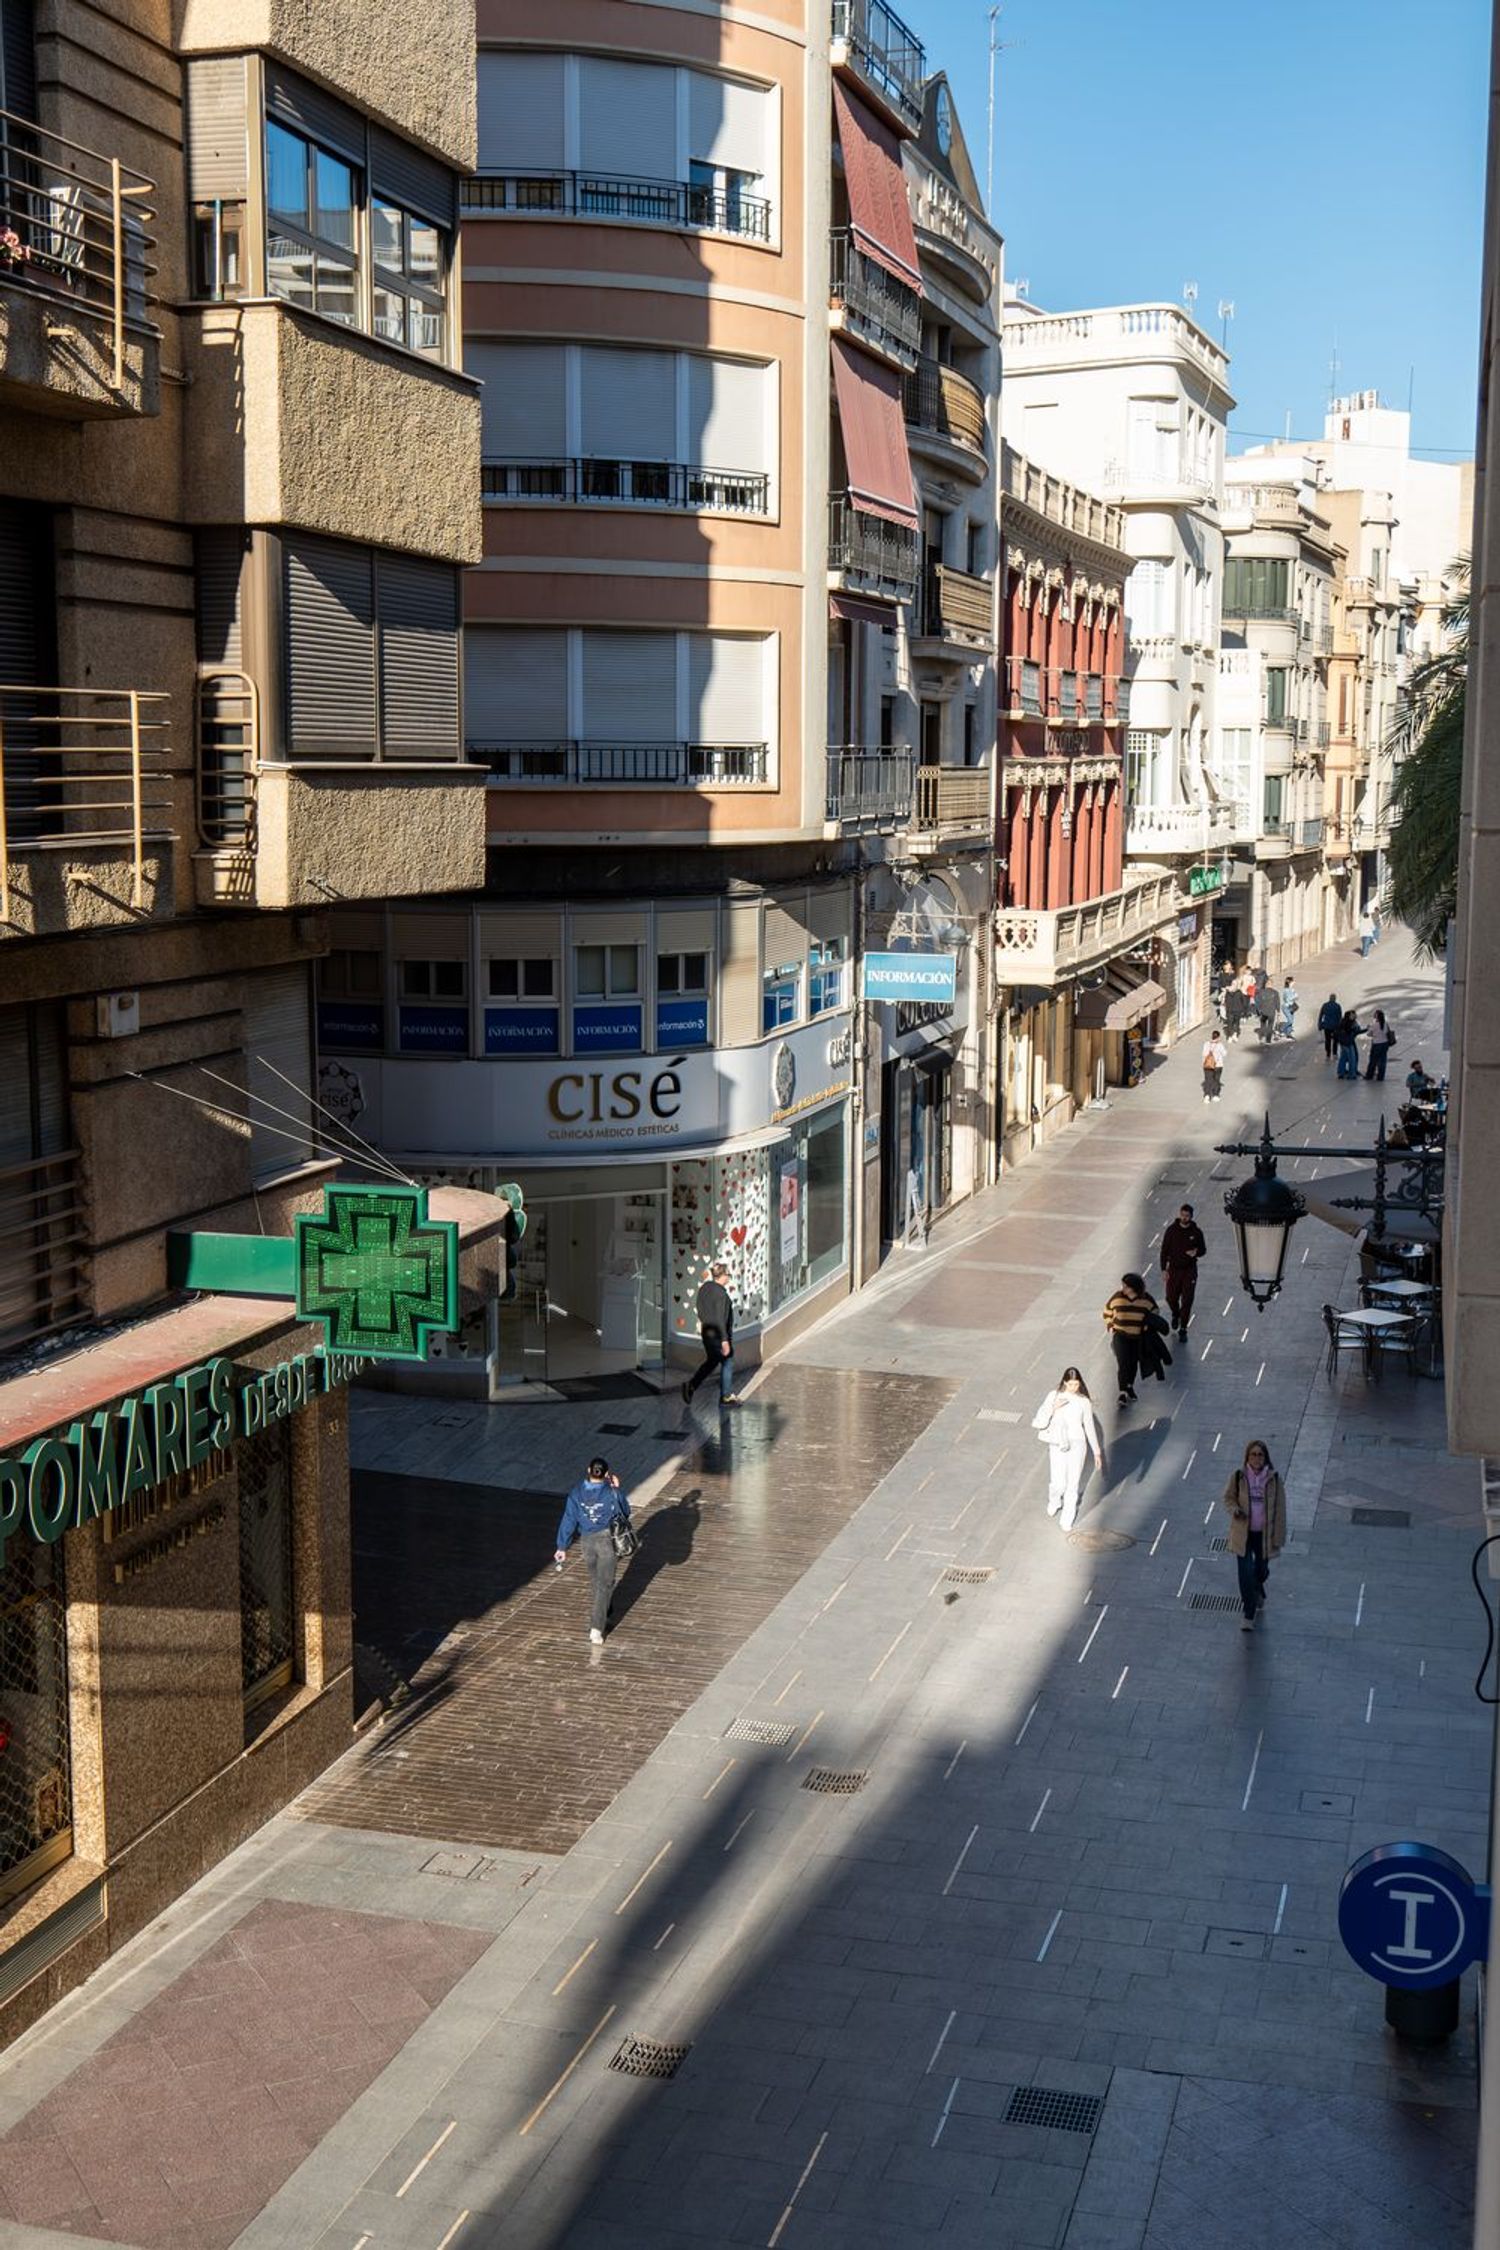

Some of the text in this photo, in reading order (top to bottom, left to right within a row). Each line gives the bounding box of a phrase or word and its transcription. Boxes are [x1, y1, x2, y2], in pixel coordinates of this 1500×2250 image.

[866, 970, 952, 985] INFORMACIÓN
[488, 1025, 554, 1037] INFORMACIÓN
[577, 1024, 638, 1036] INFORMACIÓN
[0, 1357, 237, 1569] POMARES
[242, 1354, 316, 1437] DESDE
